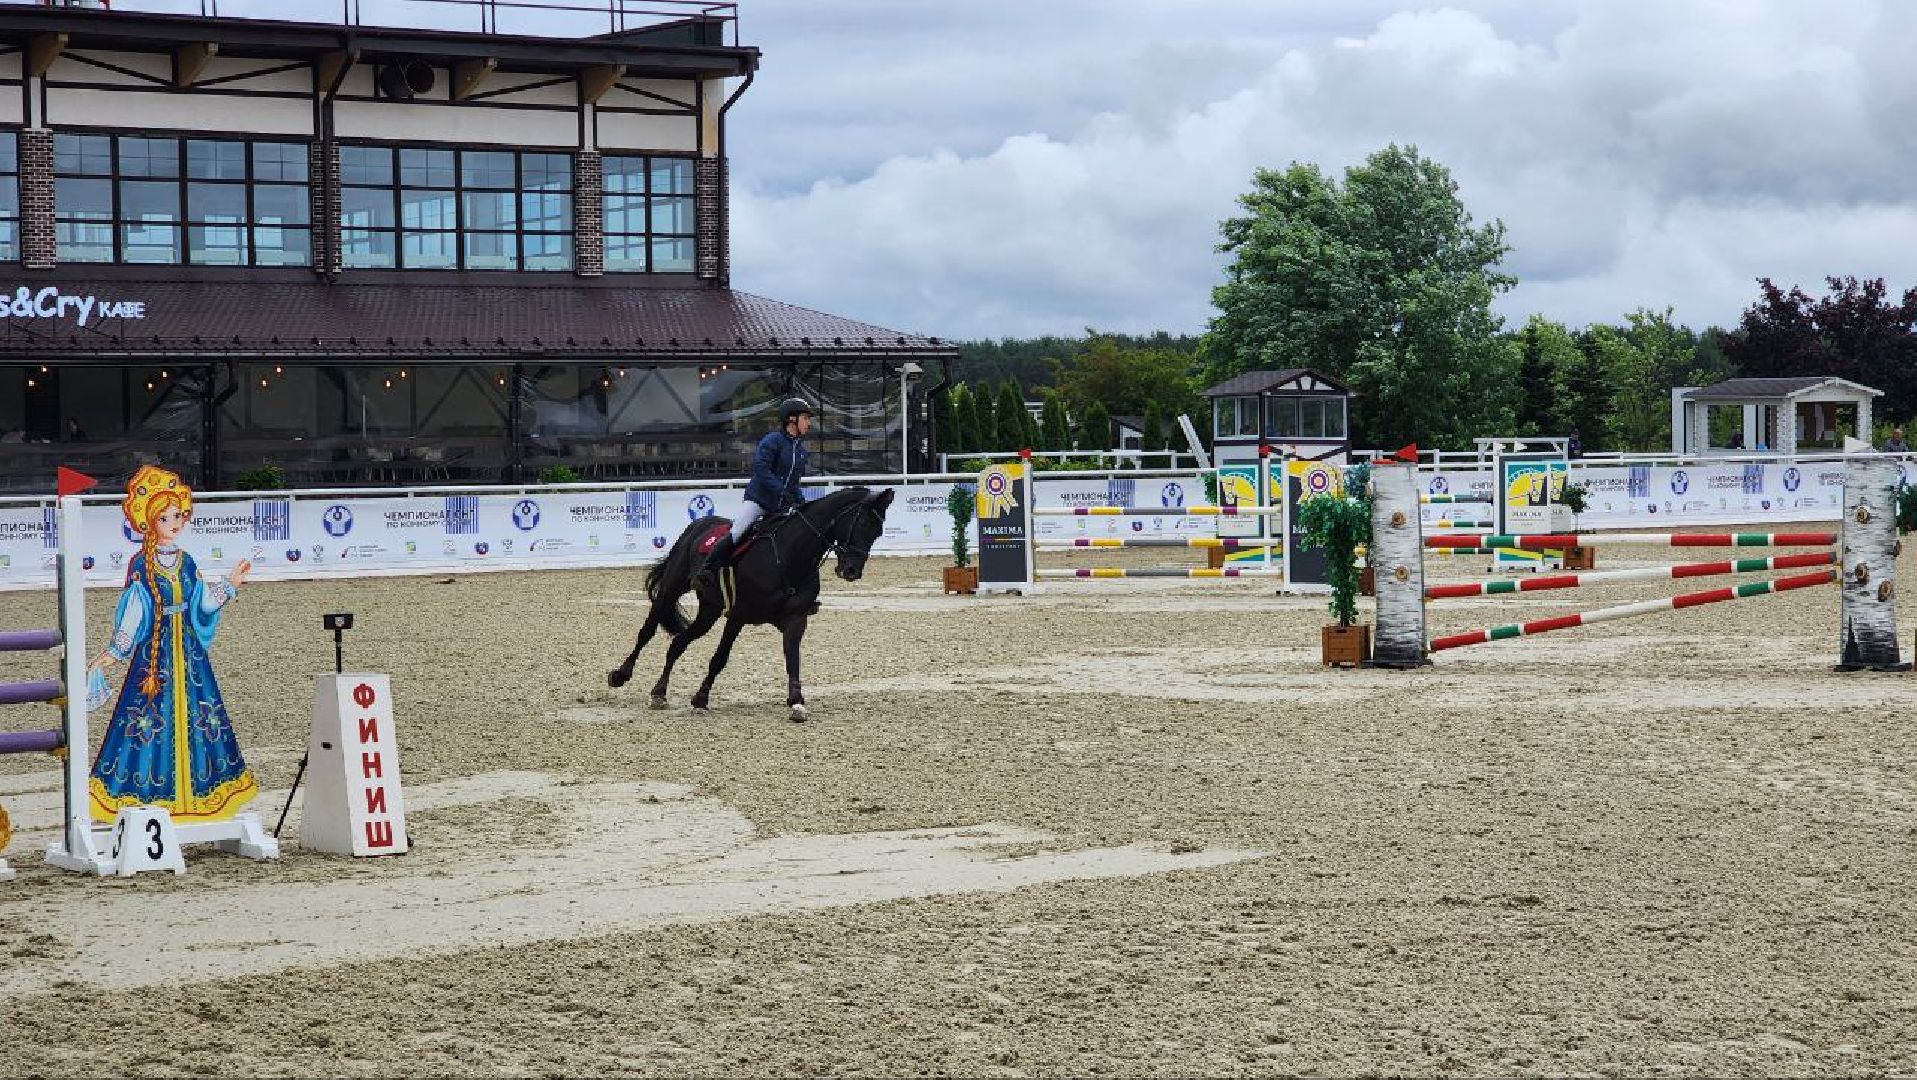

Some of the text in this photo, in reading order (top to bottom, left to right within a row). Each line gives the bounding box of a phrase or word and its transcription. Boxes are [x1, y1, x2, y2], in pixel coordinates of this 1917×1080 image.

[99, 301, 146, 318] КАФЕ
[383, 509, 450, 521] ЧЕМПИОНАТ
[569, 504, 630, 516] ЧЕМПИОНАТ
[190, 515, 260, 527] ЧЕМПИОНАТ
[982, 526, 1023, 535] MAXIMA
[352, 682, 394, 848] ФИНИШ
[145, 818, 163, 860] 3
